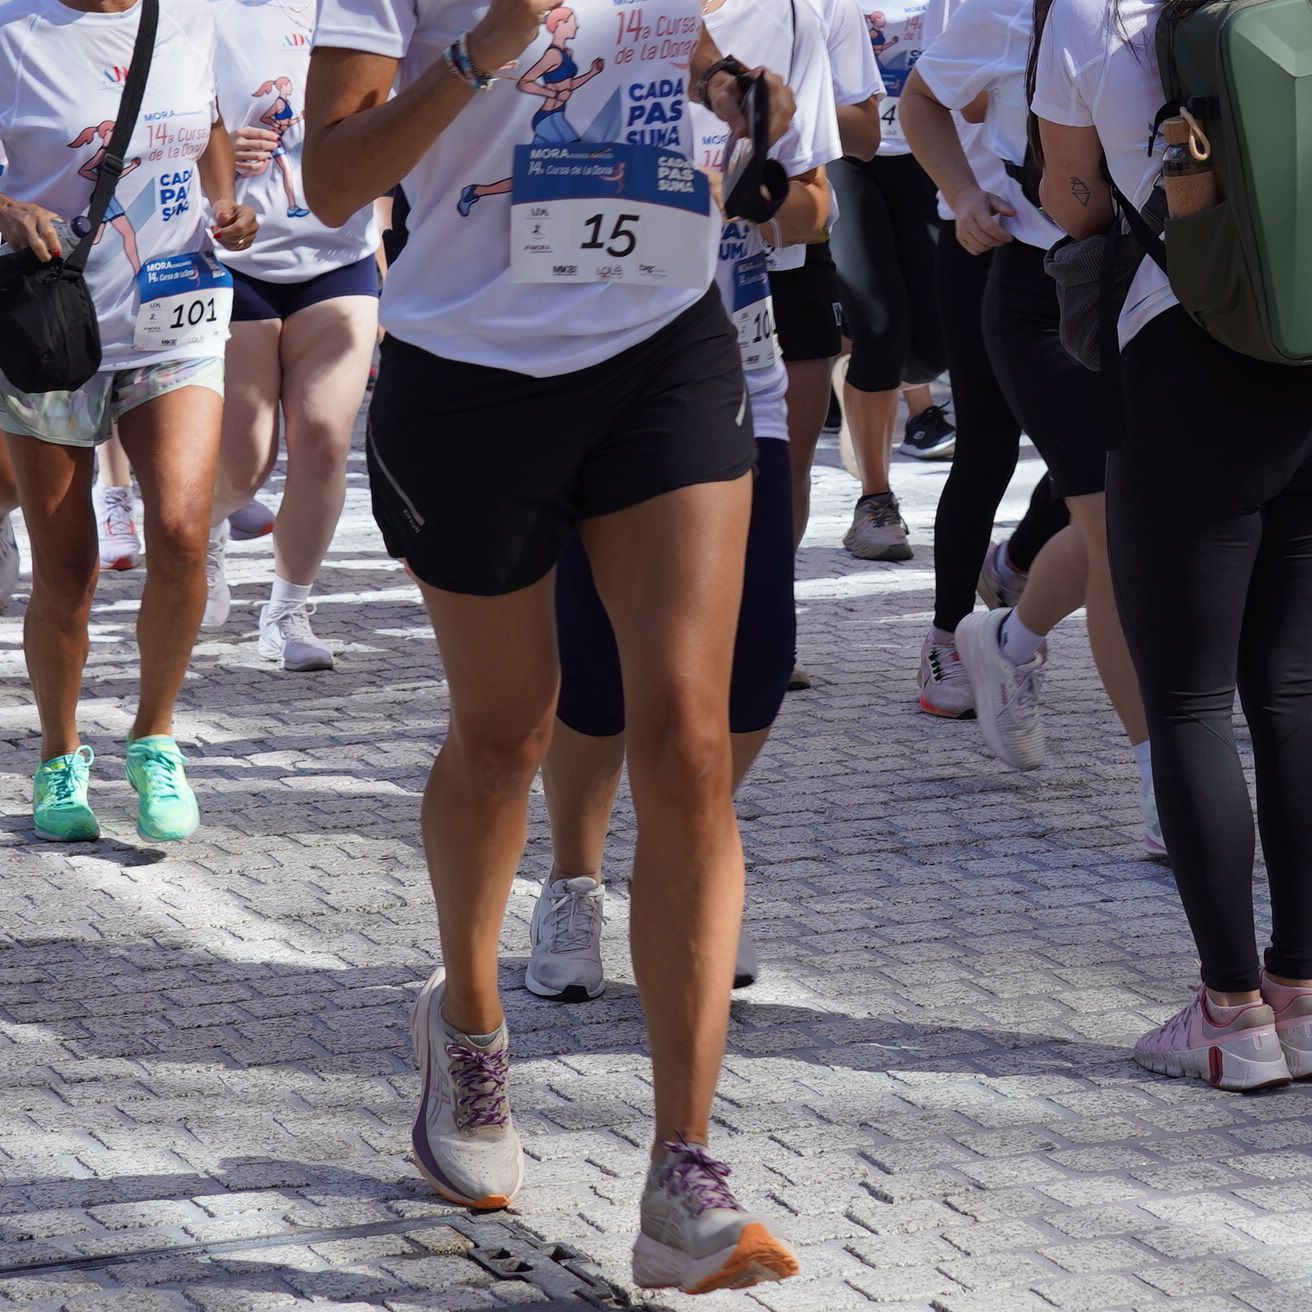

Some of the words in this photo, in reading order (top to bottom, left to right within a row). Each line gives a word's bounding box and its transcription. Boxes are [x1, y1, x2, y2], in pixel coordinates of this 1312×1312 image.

[614, 47, 634, 66] de
[640, 43, 658, 60] la
[628, 77, 684, 103] CADA
[144, 110, 176, 122] MORA
[626, 99, 684, 128] PAS
[148, 148, 163, 162] de
[530, 148, 569, 160] MORA
[657, 166, 695, 182] PAS
[159, 181, 192, 205] PA
[580, 213, 641, 258] 15
[719, 241, 747, 262] UM
[146, 261, 172, 273] MORA
[169, 296, 218, 329] 101
